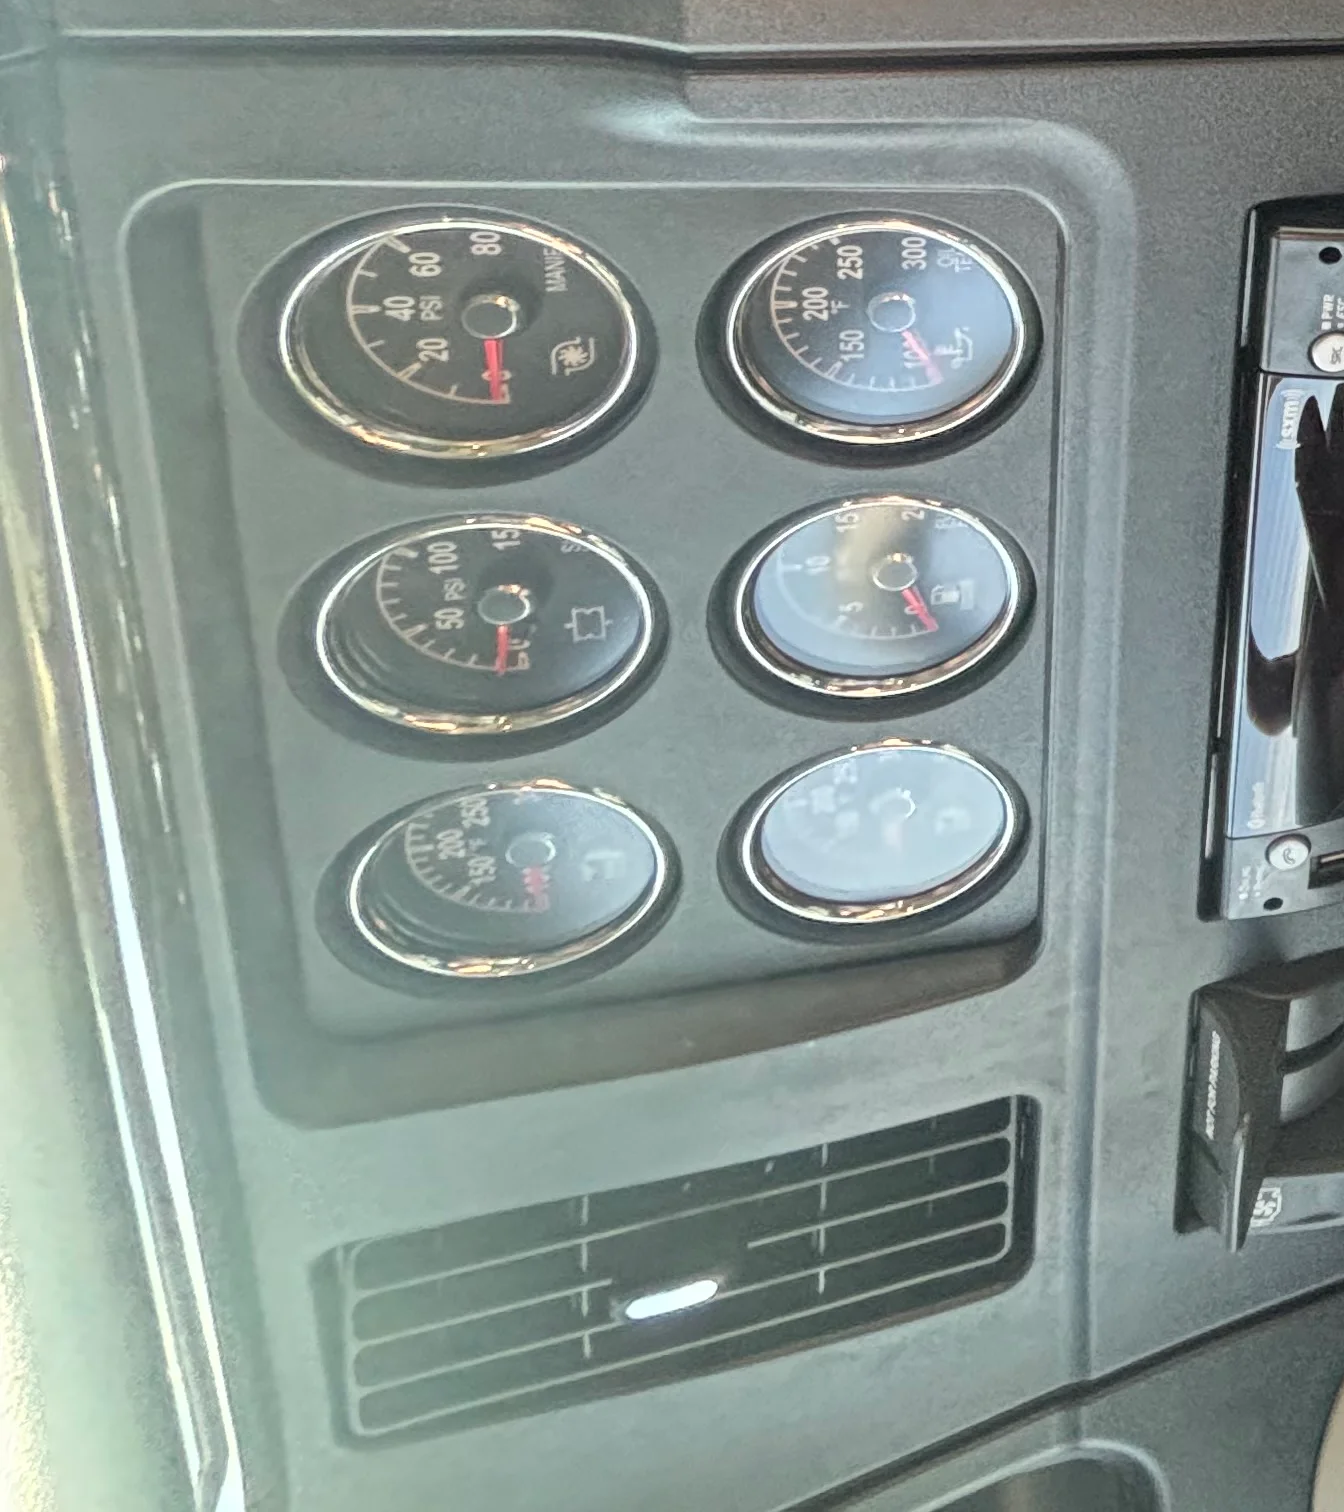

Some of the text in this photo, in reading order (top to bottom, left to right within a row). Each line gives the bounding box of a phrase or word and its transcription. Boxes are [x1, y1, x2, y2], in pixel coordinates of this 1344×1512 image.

[470, 231, 501, 255] 80
[902, 237, 927, 270] 300
[409, 252, 441, 277] 60
[837, 245, 863, 280] 250
[383, 297, 415, 321] 40
[420, 295, 443, 321] PSI
[802, 287, 829, 321] 200
[1321, 294, 1335, 320] PWR
[416, 338, 449, 361] 20
[839, 330, 864, 361] 150
[491, 529, 521, 550] 15
[428, 541, 459, 574] 100
[443, 577, 466, 601] PSI
[434, 608, 464, 630] 50
[460, 798, 490, 828] 250
[436, 828, 465, 860] 200
[467, 856, 497, 885] 150
